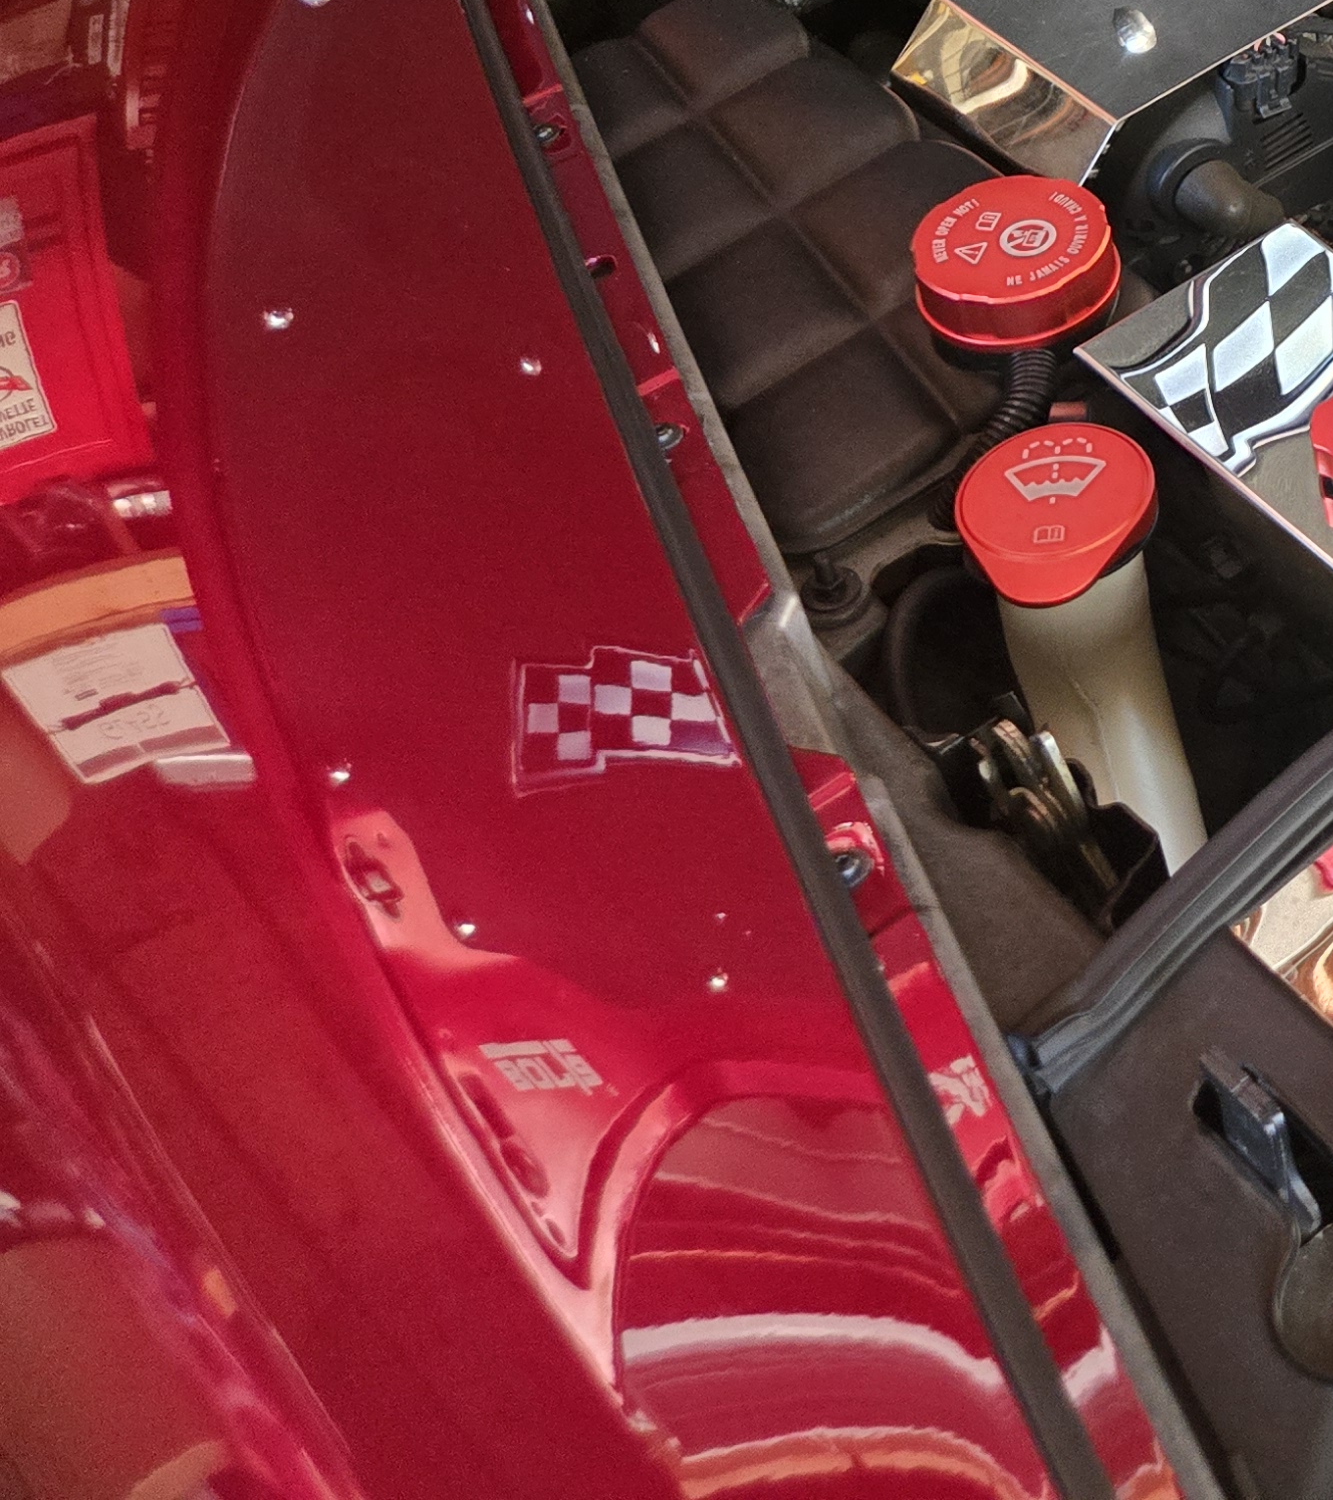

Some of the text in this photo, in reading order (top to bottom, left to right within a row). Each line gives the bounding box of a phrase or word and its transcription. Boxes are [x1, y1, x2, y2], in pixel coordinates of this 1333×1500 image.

[1048, 191, 1083, 215] CHAUD!
[931, 198, 980, 264] NEVER OPEN HOT!
[1067, 224, 1089, 255] OUVRIR
[1006, 275, 1023, 287] NE
[1029, 255, 1070, 282] JAMAIS
